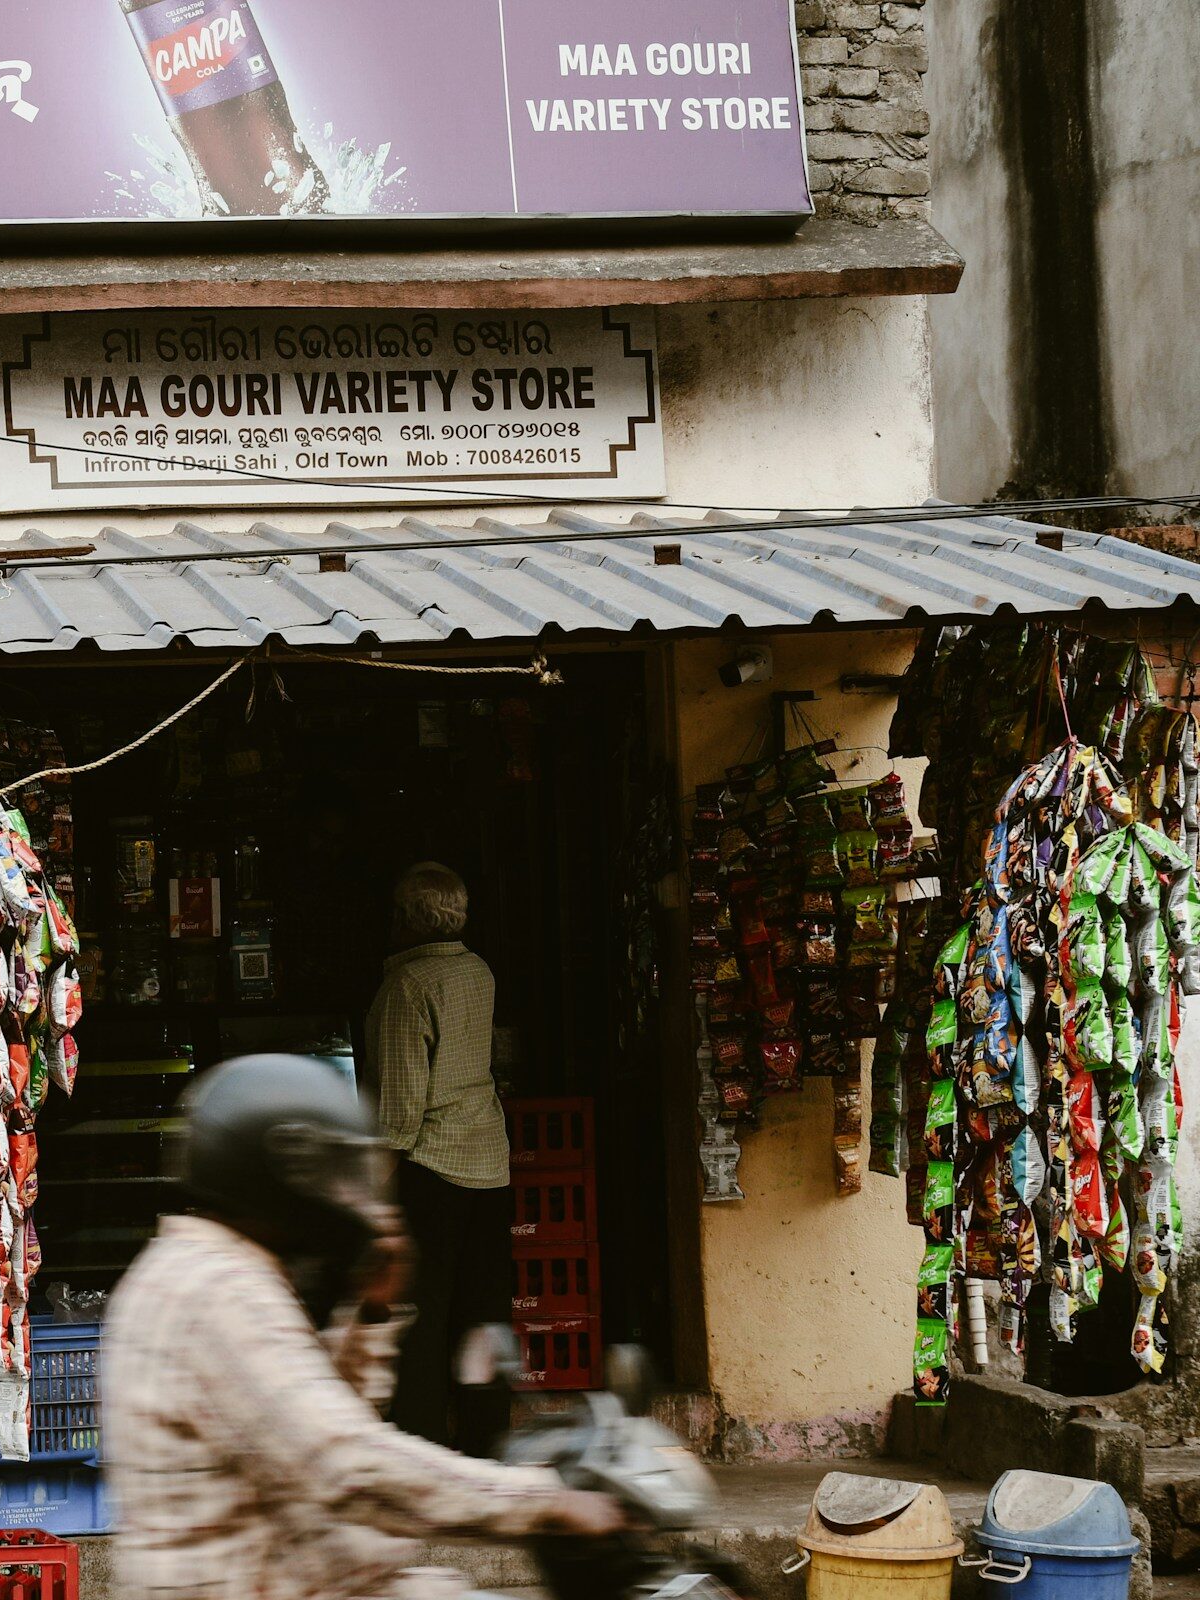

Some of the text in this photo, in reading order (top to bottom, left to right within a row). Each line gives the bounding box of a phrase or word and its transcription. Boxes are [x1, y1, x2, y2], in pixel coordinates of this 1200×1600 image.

[155, 9, 247, 81] CAMPA
[559, 42, 751, 76] MAA GOURI
[196, 64, 225, 79] COLA
[525, 97, 791, 132] VARIETY STORE
[102, 328, 141, 363] ମା
[63, 366, 596, 419] MAA GOURI VARIETY STORE
[84, 455, 151, 473] Infront
[157, 455, 176, 471] of
[182, 454, 227, 474] Darji
[234, 453, 277, 470] Sahi
[295, 451, 329, 469] Old
[336, 451, 388, 468] Town
[406, 450, 448, 467] Mob
[466, 447, 582, 465] 7008426015
